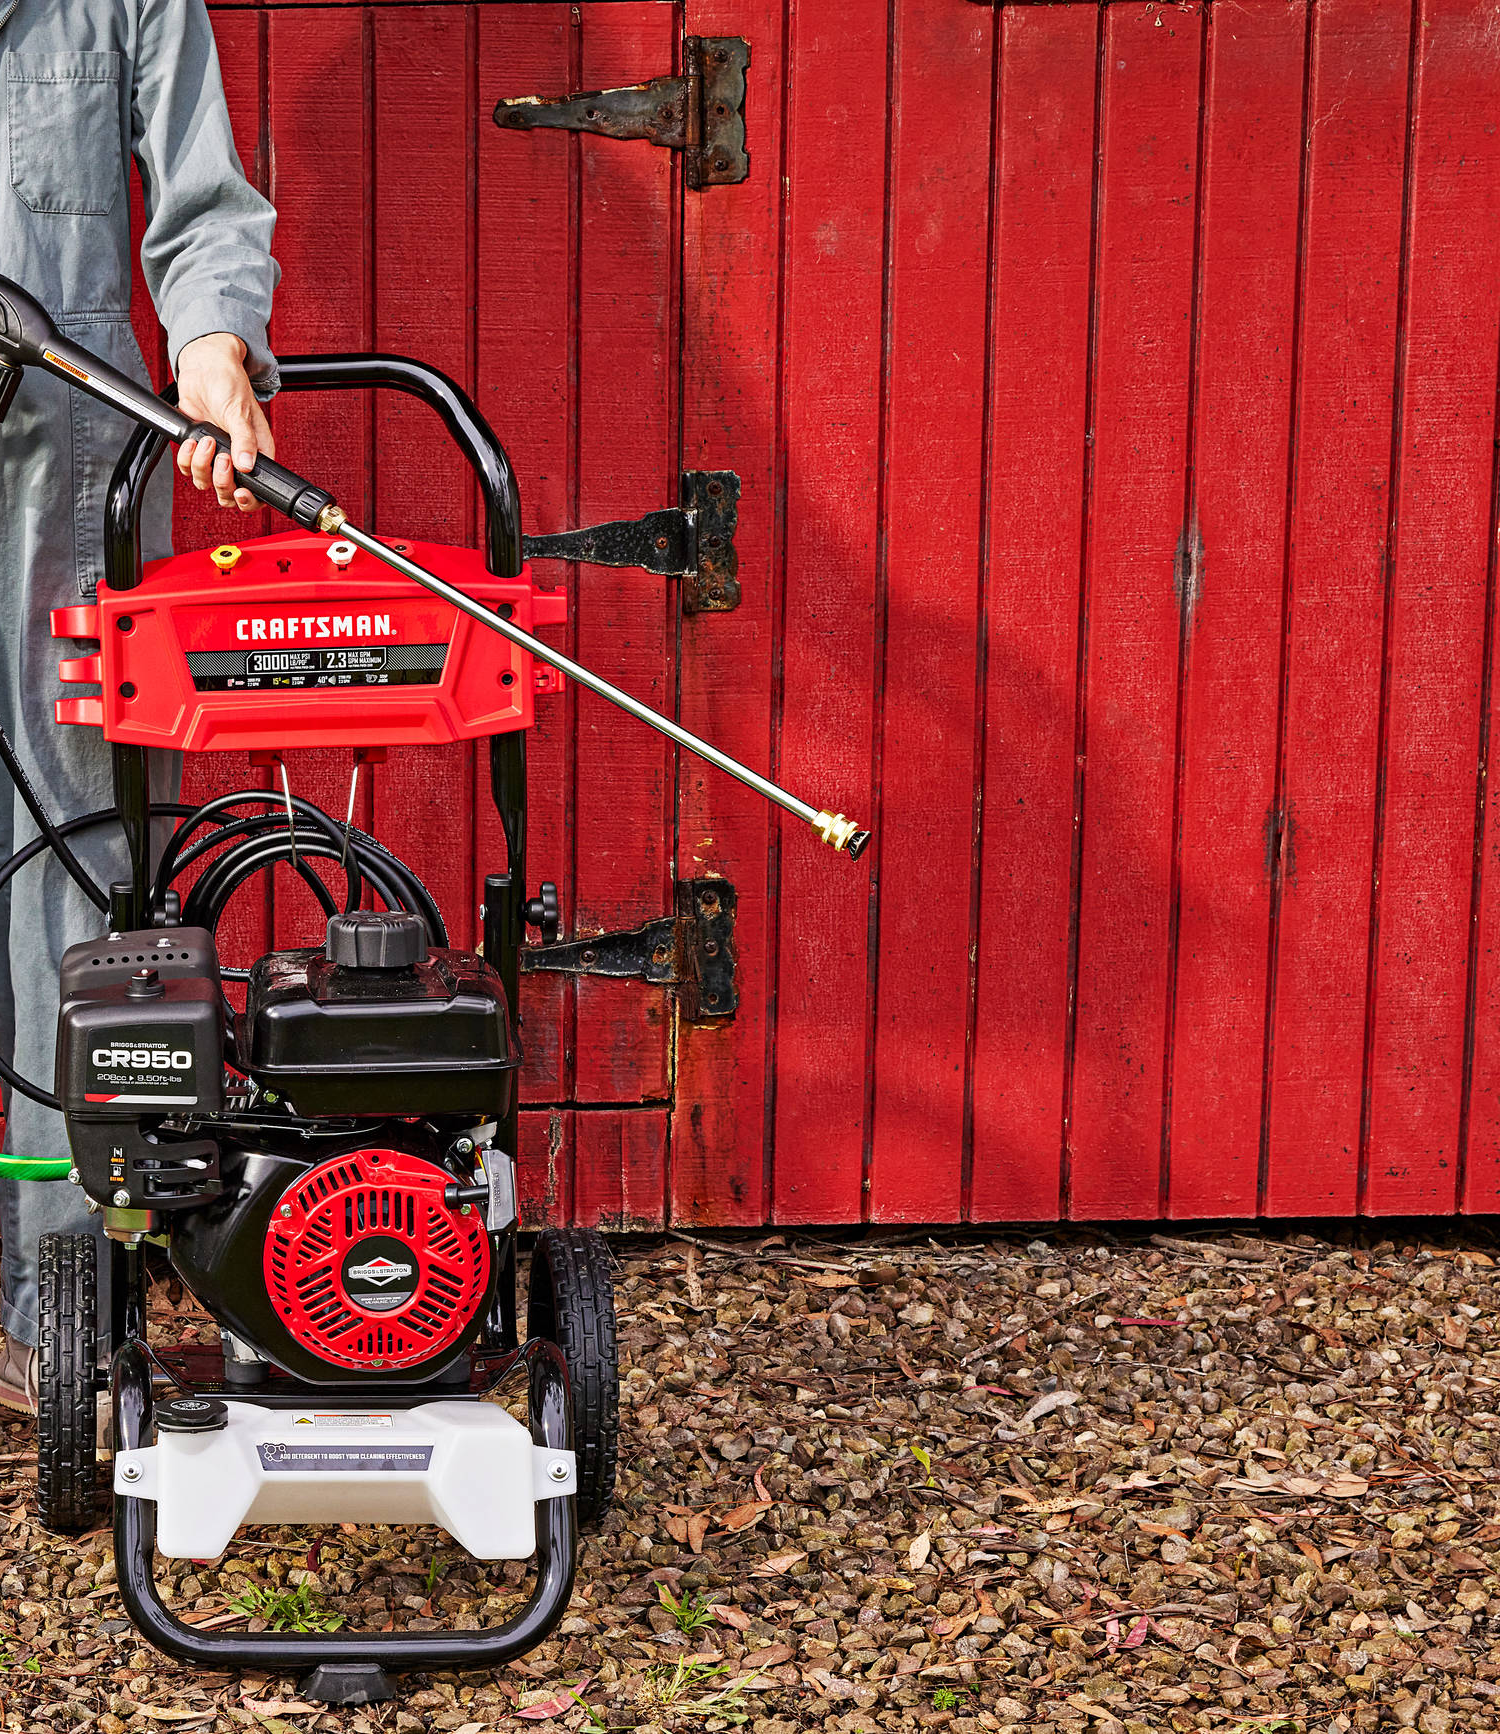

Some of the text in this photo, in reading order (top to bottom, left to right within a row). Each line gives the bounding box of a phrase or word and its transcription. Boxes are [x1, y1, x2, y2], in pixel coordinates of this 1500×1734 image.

[253, 654, 289, 671] 3000
[327, 652, 347, 669] 2.3
[92, 1049, 192, 1070] CR950
[97, 1073, 127, 1081] 208cc
